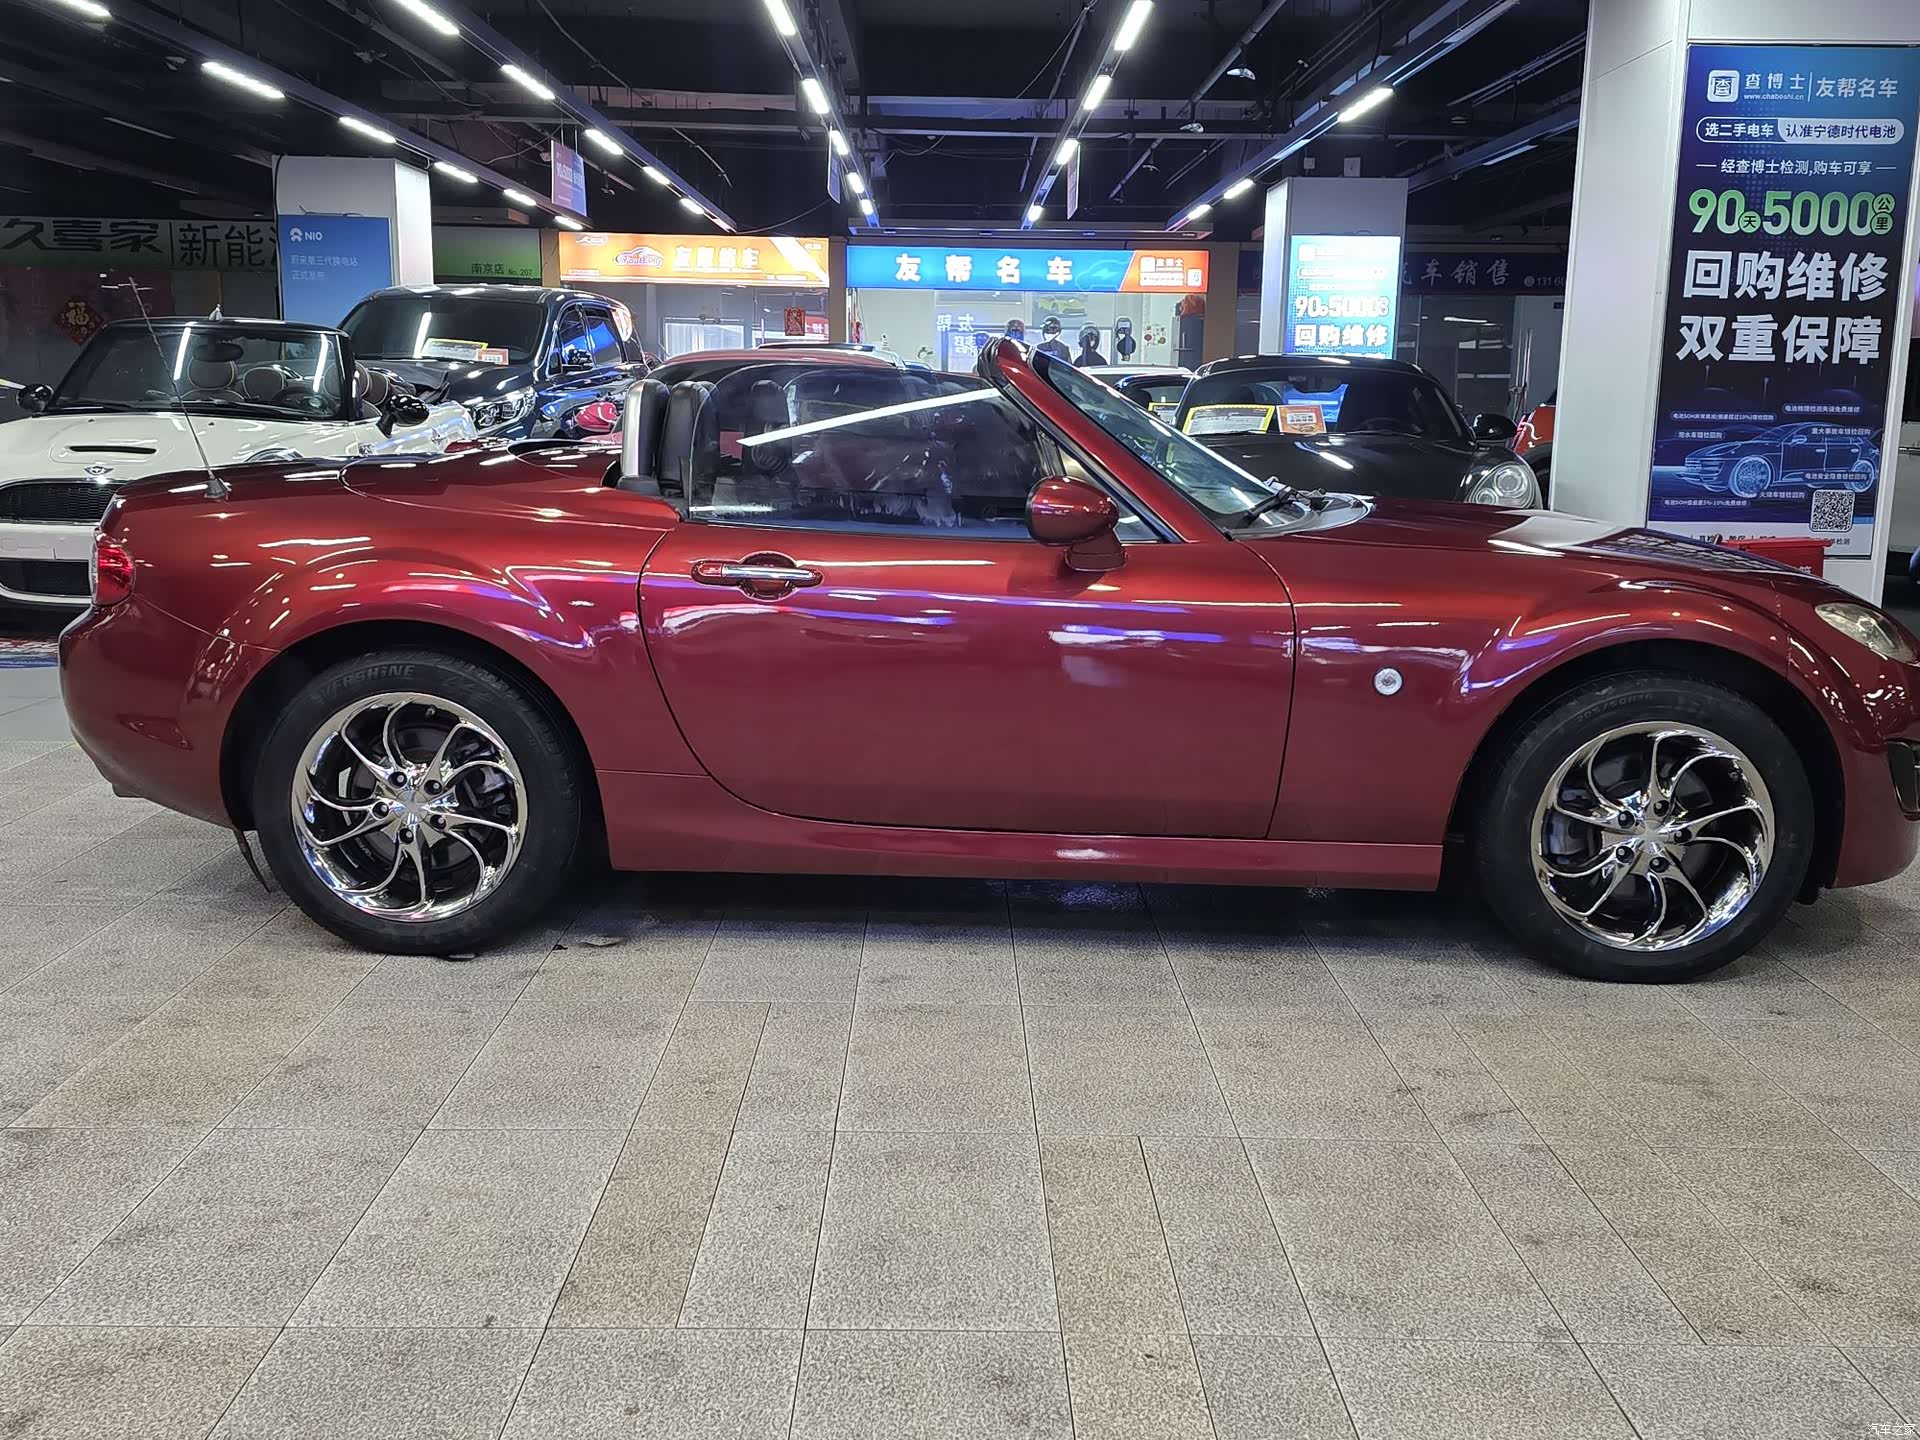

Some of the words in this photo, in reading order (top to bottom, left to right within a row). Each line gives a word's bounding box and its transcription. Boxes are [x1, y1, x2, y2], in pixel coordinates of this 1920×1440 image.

[1744, 73, 1806, 90] 查博士
[1816, 77, 1899, 98] 友帮名车
[1744, 93, 1805, 101] www.chaboshi.cn
[1705, 122, 1775, 138] 选二手电车
[1785, 124, 1896, 139] 认准宁德时代电池
[304, 231, 323, 241] NIO
[179, 223, 277, 268] 新能
[471, 263, 504, 275] 南京店
[1683, 249, 1889, 302] 回购维修
[1676, 314, 1883, 366] 双重保障
